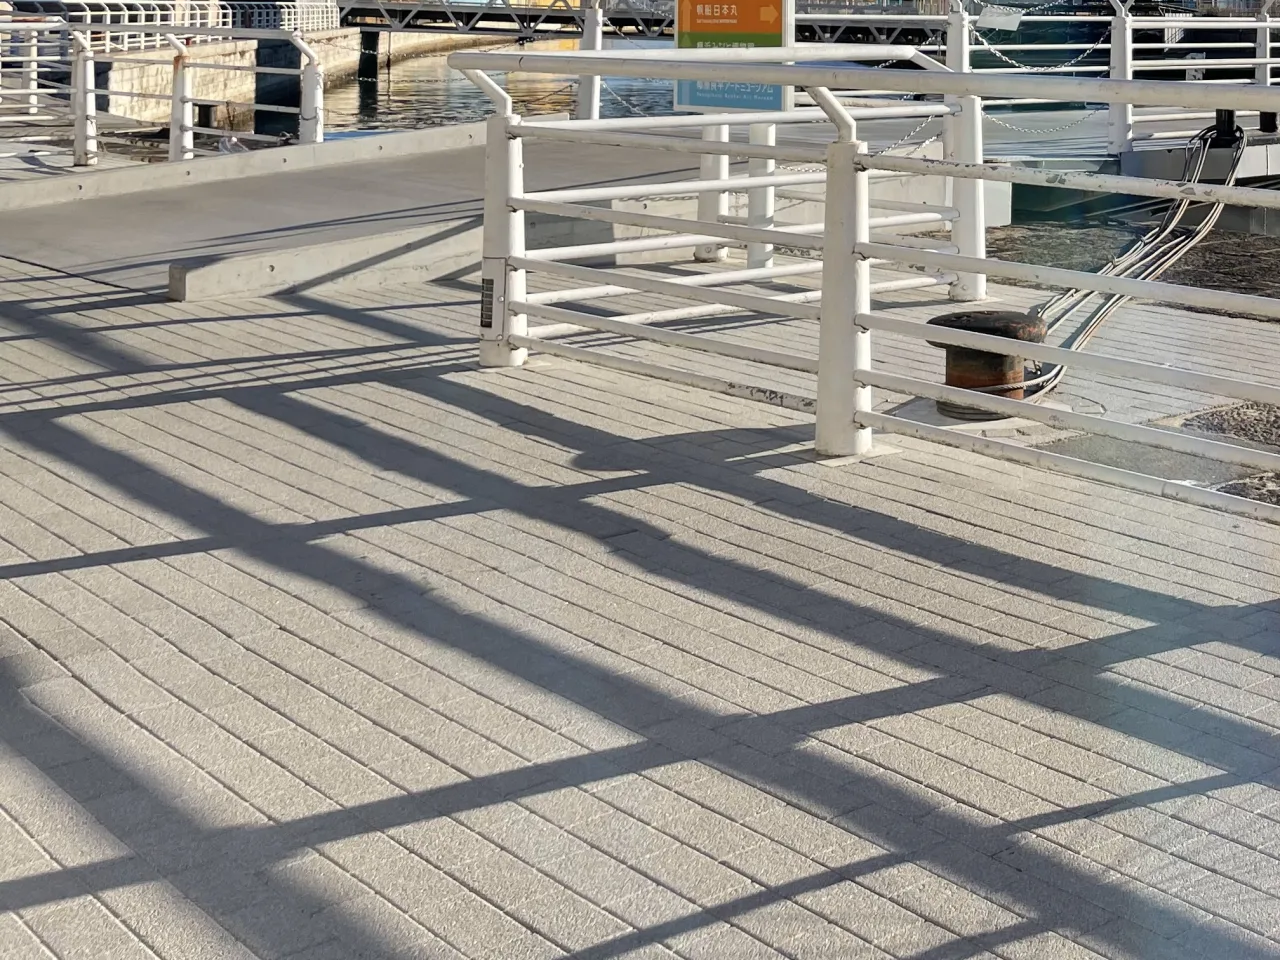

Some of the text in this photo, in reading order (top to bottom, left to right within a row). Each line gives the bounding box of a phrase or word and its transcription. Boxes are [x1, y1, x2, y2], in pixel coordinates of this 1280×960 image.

[696, 4, 738, 16] 帆船日本丸
